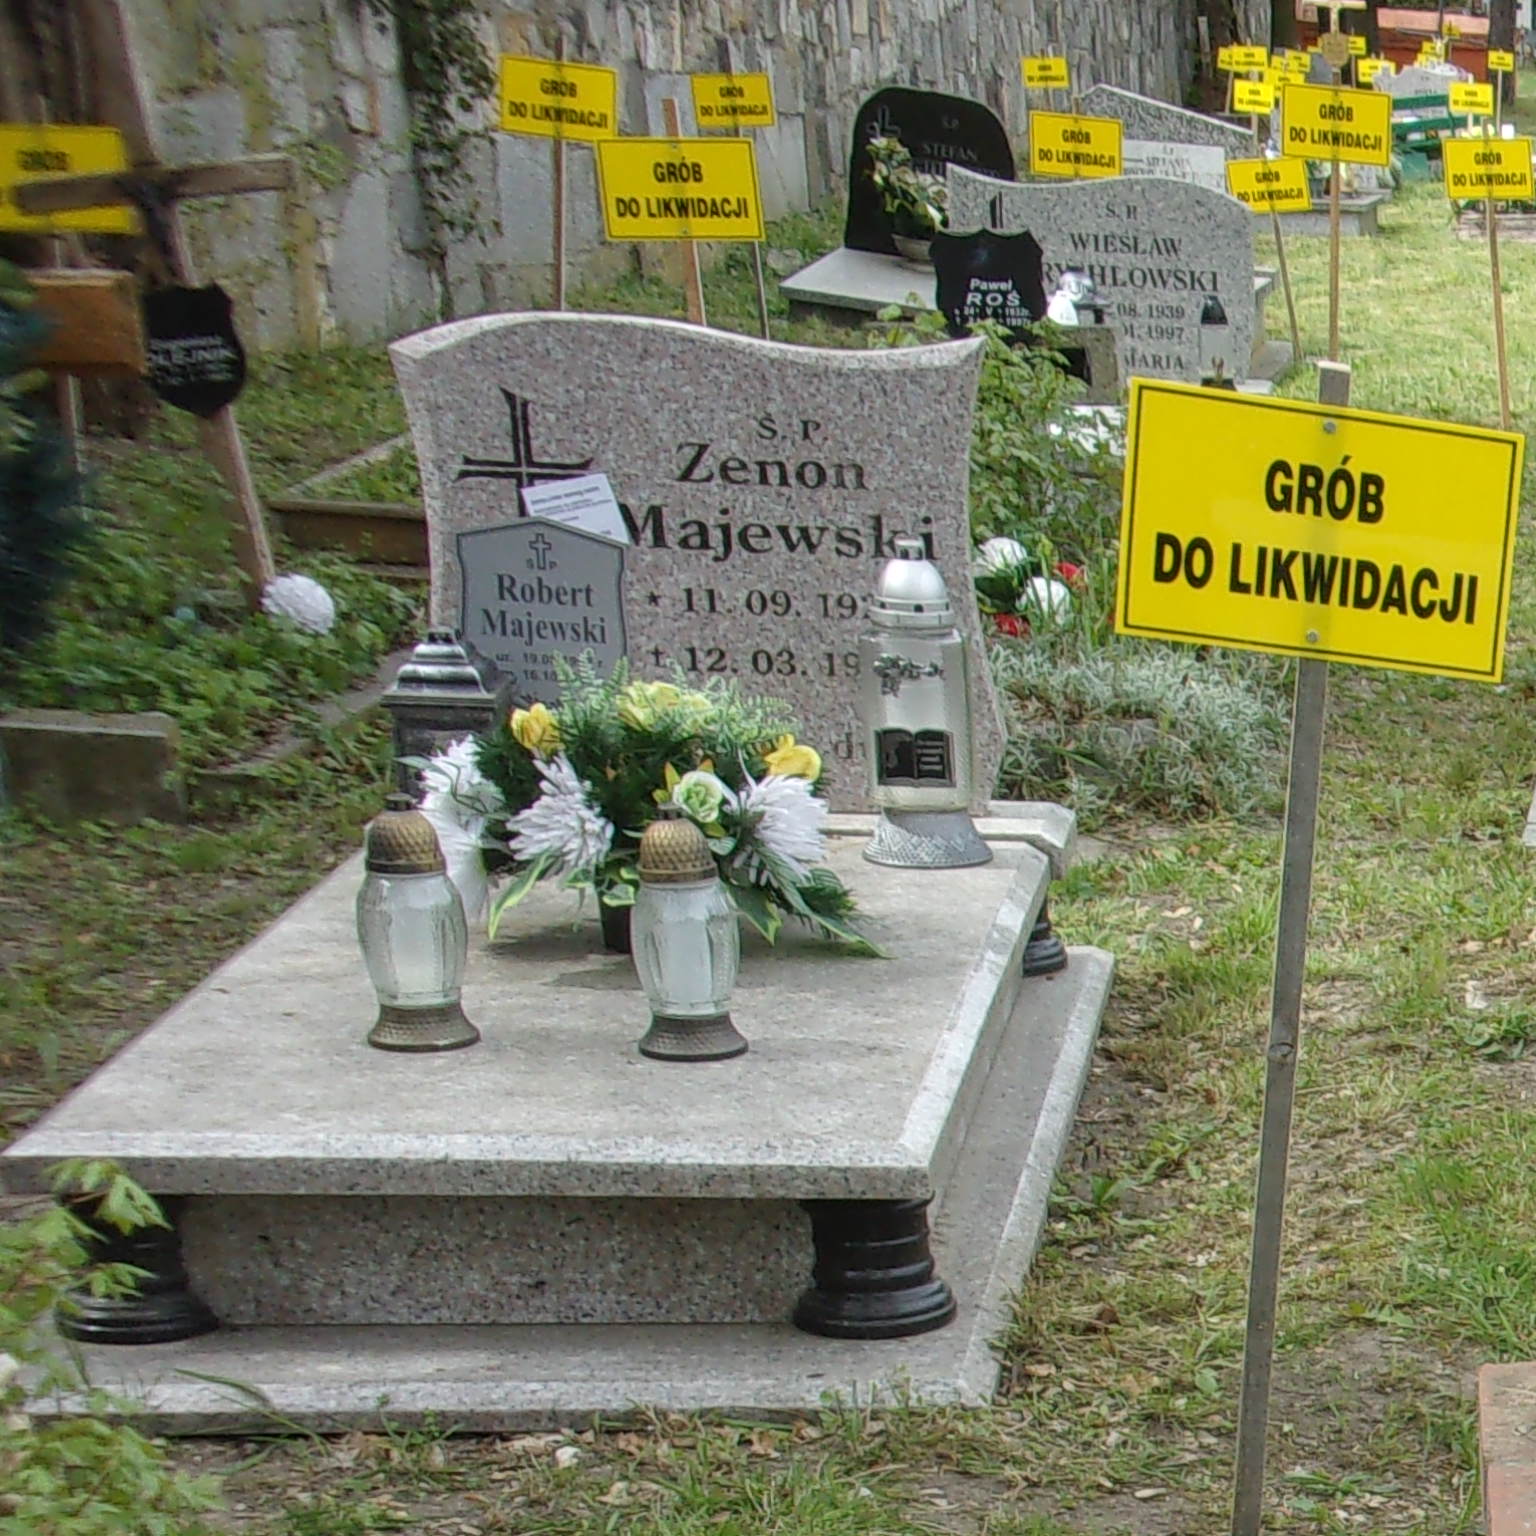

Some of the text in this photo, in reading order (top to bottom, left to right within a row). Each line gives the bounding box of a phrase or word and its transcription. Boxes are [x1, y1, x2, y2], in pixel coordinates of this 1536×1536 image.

[508, 101, 608, 130] DO LIKWIDACJI
[700, 105, 768, 117] DO LIKWIDACJI
[1319, 102, 1354, 121] GRÓB
[1062, 128, 1091, 145] GRÓB
[1289, 126, 1383, 153] DO LIKWIDACJI
[653, 156, 704, 184] GRÓB
[1038, 148, 1116, 170] DO LIKWIDACJI
[1473, 149, 1502, 166] GRÓB
[1452, 172, 1528, 187] DO LIKWIDACJI
[1237, 188, 1304, 203] DO LIKWIDACJI
[616, 197, 750, 220] DO LIKWIDACJI
[966, 289, 1021, 306] ROŚ
[1147, 304, 1185, 320] 1939
[1147, 326, 1185, 341] 1997
[674, 441, 871, 491] Zenon
[1265, 455, 1385, 524] GRÓB
[617, 502, 938, 562] Majewski
[497, 573, 595, 608] Robert
[1153, 532, 1478, 625] DO LIKWIDACJI
[683, 587, 733, 614] 11.
[744, 589, 802, 618] 09.
[481, 608, 607, 647] Majewski
[686, 647, 739, 674] 12.
[751, 649, 808, 677] 03.
